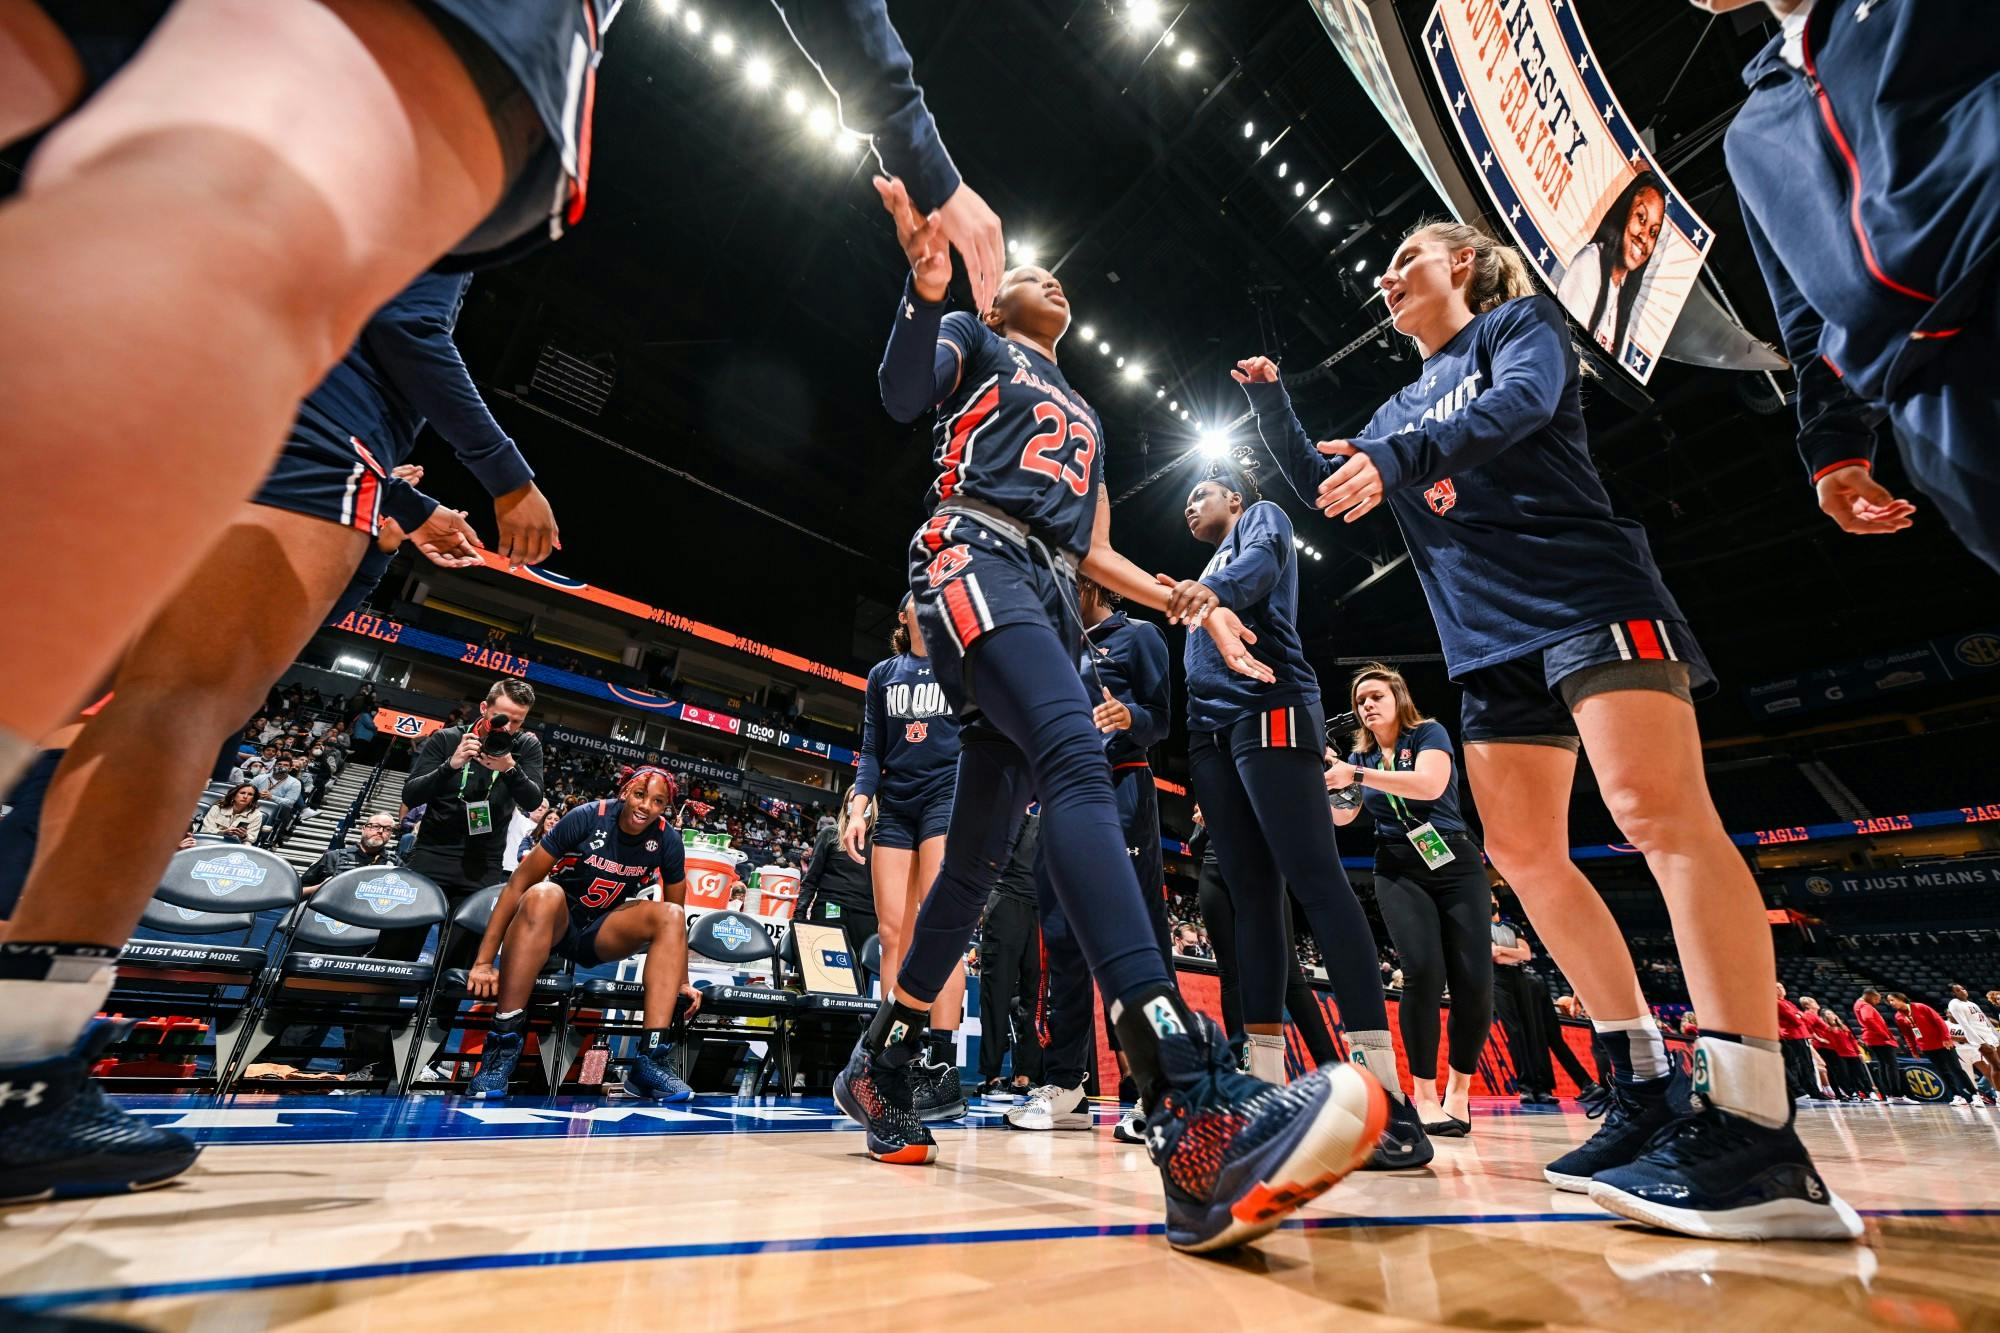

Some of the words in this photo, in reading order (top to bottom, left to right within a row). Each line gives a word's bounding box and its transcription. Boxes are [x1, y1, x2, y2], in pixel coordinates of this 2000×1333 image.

[1019, 401, 1096, 497] 23
[333, 610, 403, 644] AGLE
[460, 643, 530, 678] EAGLE
[886, 684, 909, 716] NO
[729, 719, 737, 730] 0
[747, 723, 775, 739] 10:00
[553, 730, 645, 760] SOUTHEASTERN
[782, 733, 790, 744] 0
[661, 755, 739, 781] CONFERENCE
[1755, 826, 1809, 845] EAGLE
[1853, 815, 1913, 835] EAGLE
[196, 862, 262, 879] BASKETBALL
[584, 854, 648, 877] AUBURN
[359, 883, 415, 899] BASKETBALL
[1842, 879, 1859, 892] IT
[1862, 876, 1909, 891] JUST
[1914, 869, 1987, 888] MEANS
[580, 877, 626, 909] 51
[130, 946, 142, 955] IT
[144, 947, 169, 957] JUST
[171, 949, 207, 959] MEANS
[208, 952, 240, 962] MORE.
[324, 960, 333, 968] IT
[334, 961, 355, 970] JUST
[357, 963, 386, 973] MEANS
[387, 966, 413, 975] MORE.
[624, 984, 639, 992] JUST
[1906, 1069, 1940, 1097] SEC
